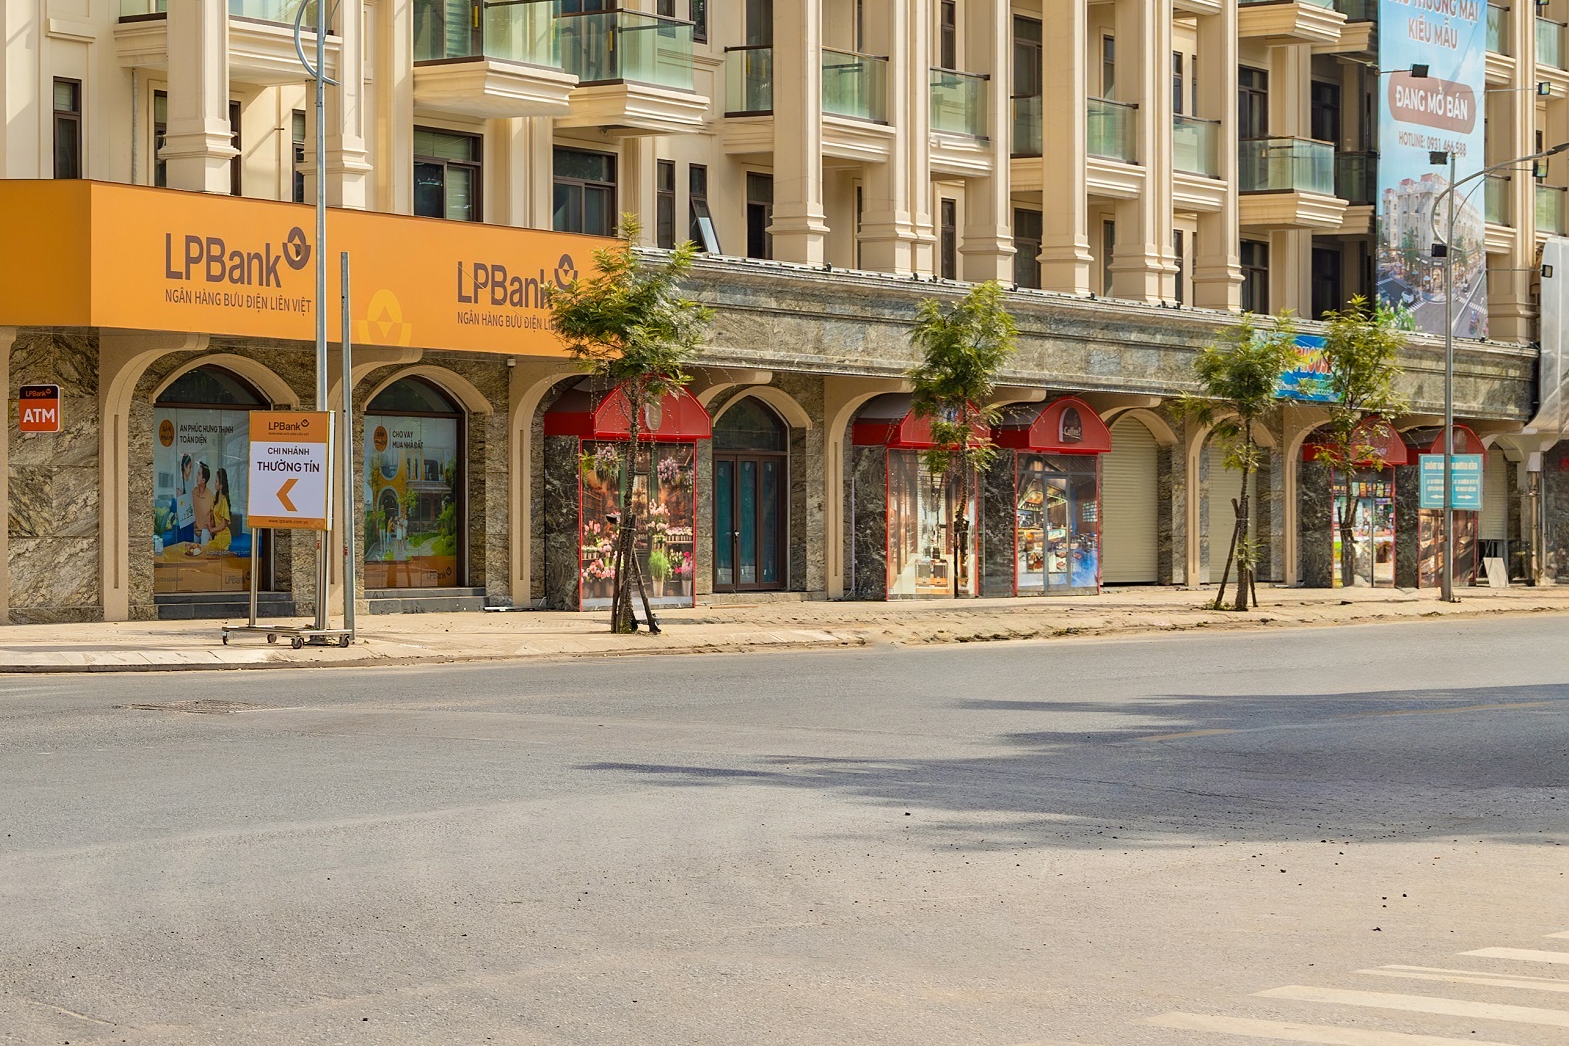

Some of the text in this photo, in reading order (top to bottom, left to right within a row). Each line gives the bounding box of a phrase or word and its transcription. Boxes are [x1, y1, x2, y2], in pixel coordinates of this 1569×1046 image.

[1395, 85, 1468, 120] ĐANG MỞ BÁN
[1398, 131, 1426, 149] HOTLINE:
[165, 233, 282, 288] LPBank
[457, 261, 553, 310] LPBank
[165, 287, 312, 316] NGÂN HÀNG BƯU ĐIỆN LIÊN VIỆT
[457, 310, 480, 325] NGÂN
[481, 311, 503, 327] HÀNG
[505, 313, 522, 329] BƯU
[524, 315, 543, 333] ĐIỆN
[22, 408, 56, 423] ATM
[179, 423, 234, 435] AN PHÚC HƯNG THỊNH
[268, 421, 301, 431] LPBank
[179, 434, 194, 443] TOÀN
[392, 430, 403, 438] CHO
[404, 431, 414, 439] VAY
[267, 445, 310, 456] CHI NHÁNH
[392, 441, 404, 449] MUA
[257, 459, 320, 472] THƯỜNG TÍN
